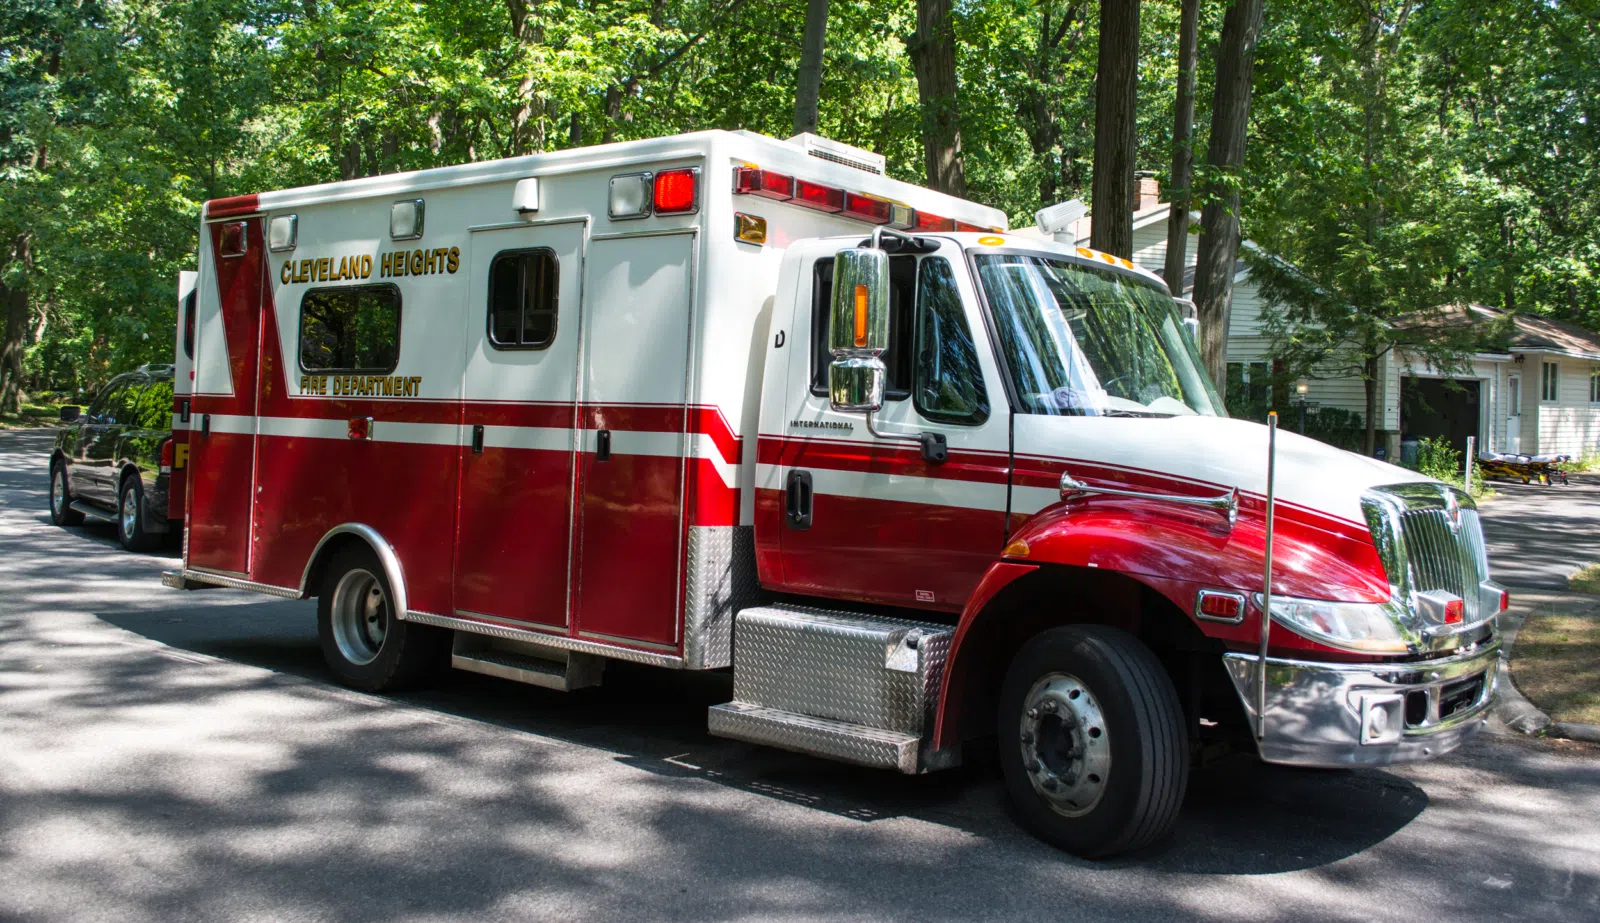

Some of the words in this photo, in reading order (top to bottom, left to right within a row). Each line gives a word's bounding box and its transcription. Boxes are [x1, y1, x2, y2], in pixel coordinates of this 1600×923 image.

[281, 254, 373, 285] CLEVELAND
[380, 247, 460, 278] HEIGHTS
[300, 376, 327, 395] FIRE
[333, 376, 422, 397] DEPARTMENT
[790, 420, 854, 430] INTERNATIONAL
